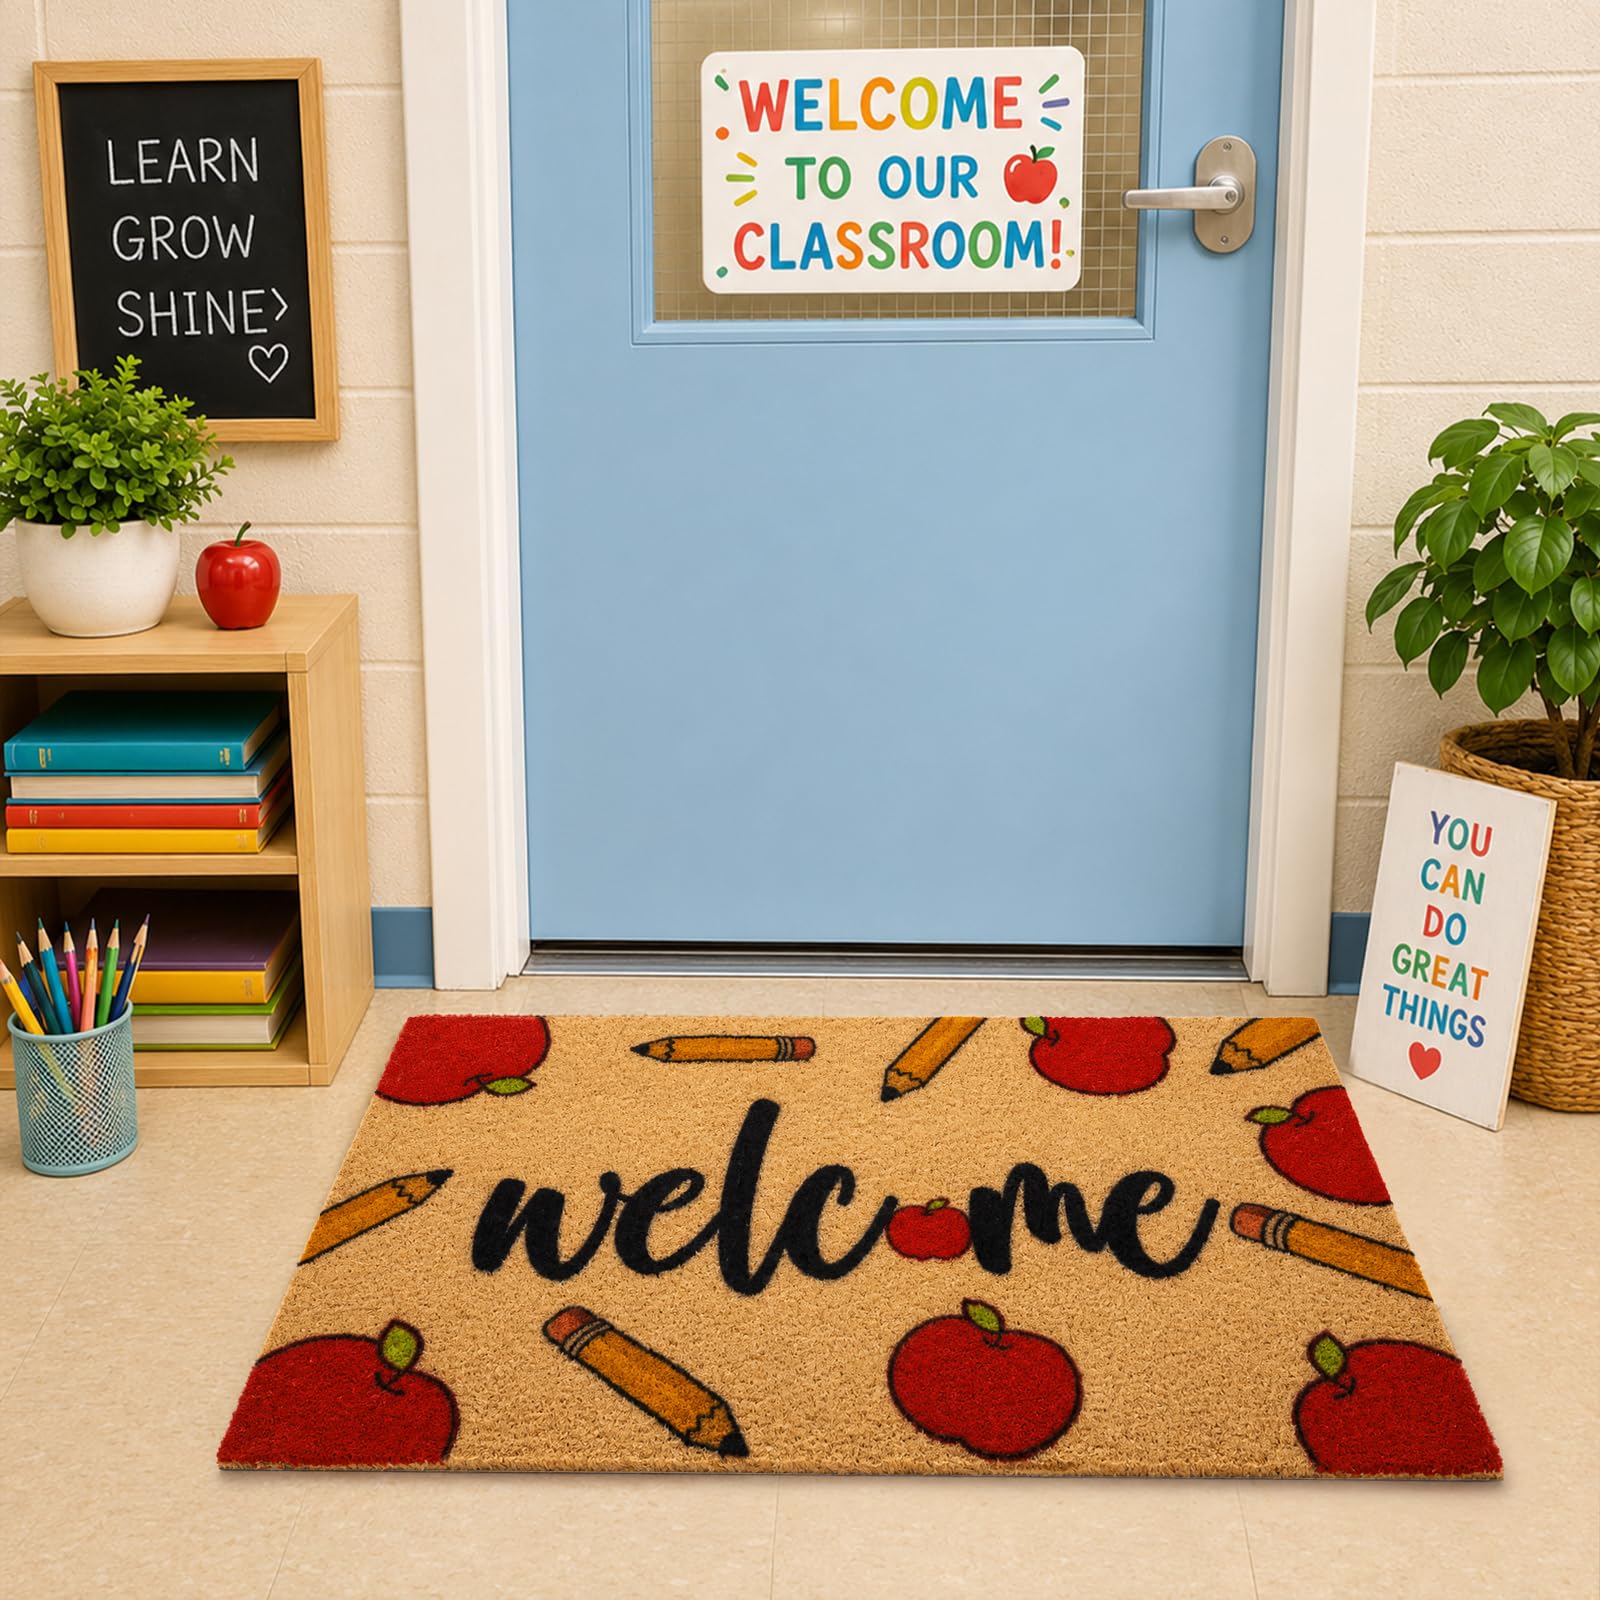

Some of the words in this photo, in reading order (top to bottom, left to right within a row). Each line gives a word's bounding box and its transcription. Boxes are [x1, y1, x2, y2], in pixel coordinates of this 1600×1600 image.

[738, 75, 1023, 132] WELCOME
[107, 137, 258, 186] LEARN
[785, 155, 852, 200] TO
[878, 154, 978, 200] OUR
[112, 214, 255, 262] GROW
[733, 219, 1063, 271] CLASSROOM!
[1430, 810, 1493, 858] YOU
[1420, 857, 1486, 906] CAN
[1422, 904, 1467, 946] DO
[1391, 943, 1490, 1001] GREAT
[1382, 983, 1487, 1049] THINGS
[471, 1098, 1220, 1296] welcme
